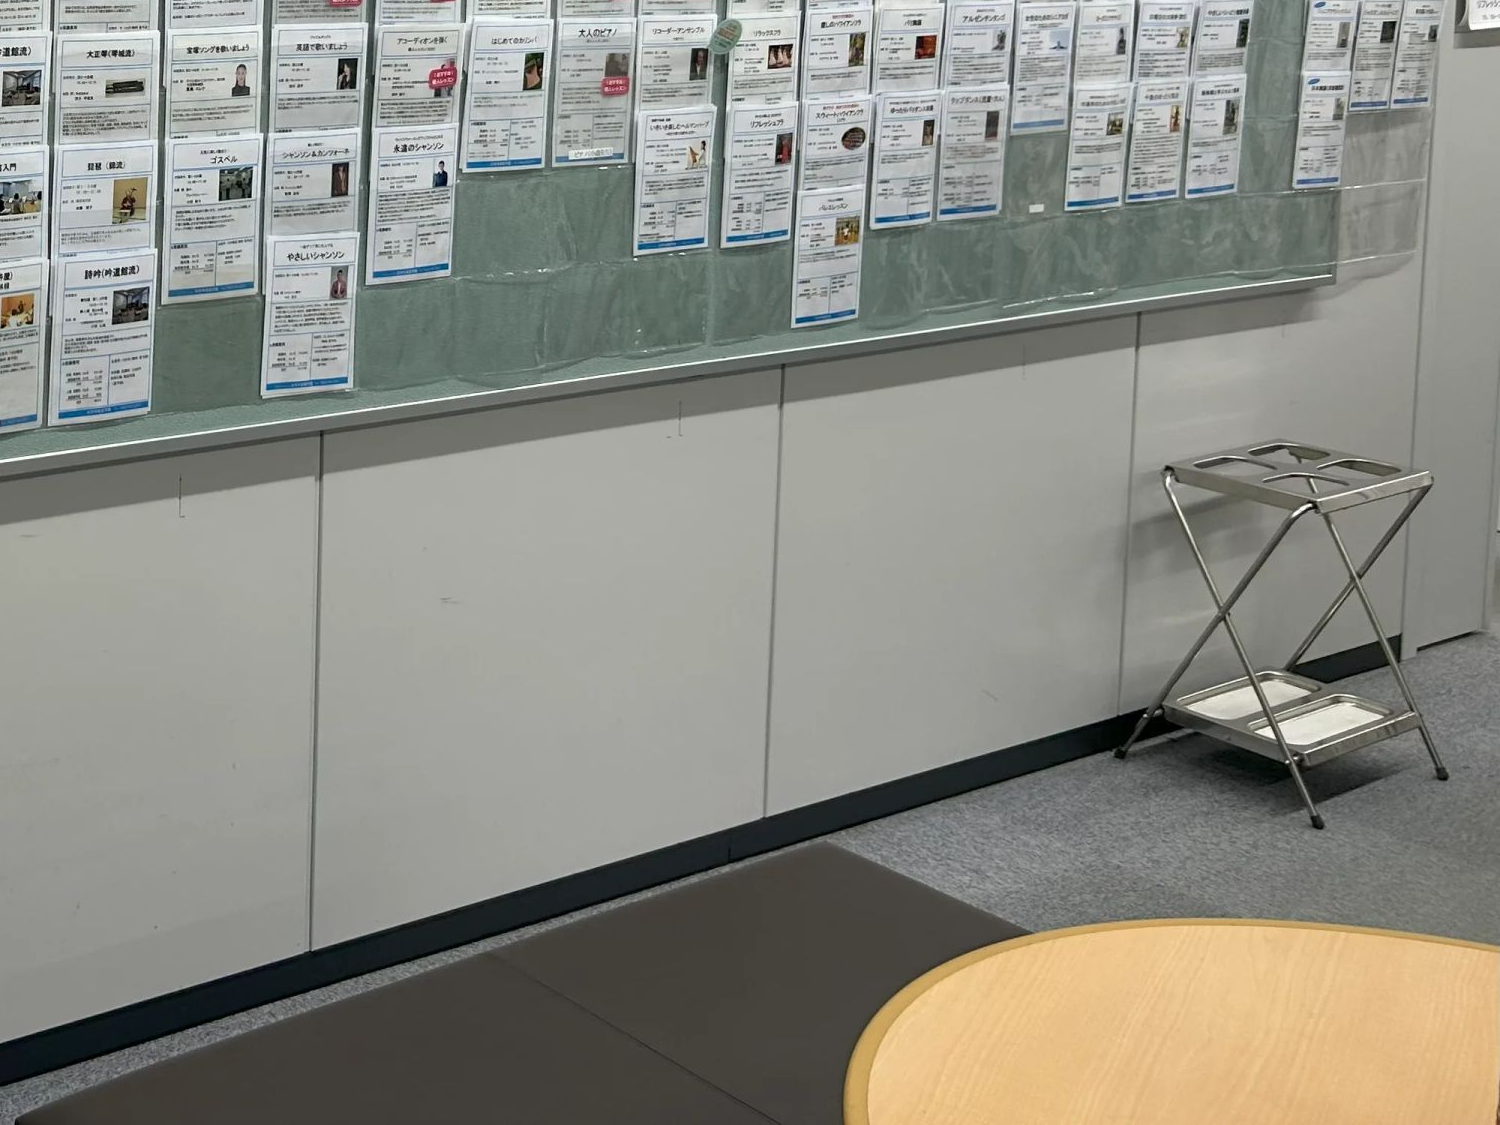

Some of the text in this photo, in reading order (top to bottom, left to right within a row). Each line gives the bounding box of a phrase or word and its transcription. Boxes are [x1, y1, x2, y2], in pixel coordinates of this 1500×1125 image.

[578, 28, 617, 38] 大人のピアノ
[210, 155, 237, 164] ゴスペル
[287, 252, 345, 261] やさしいシャンソン
